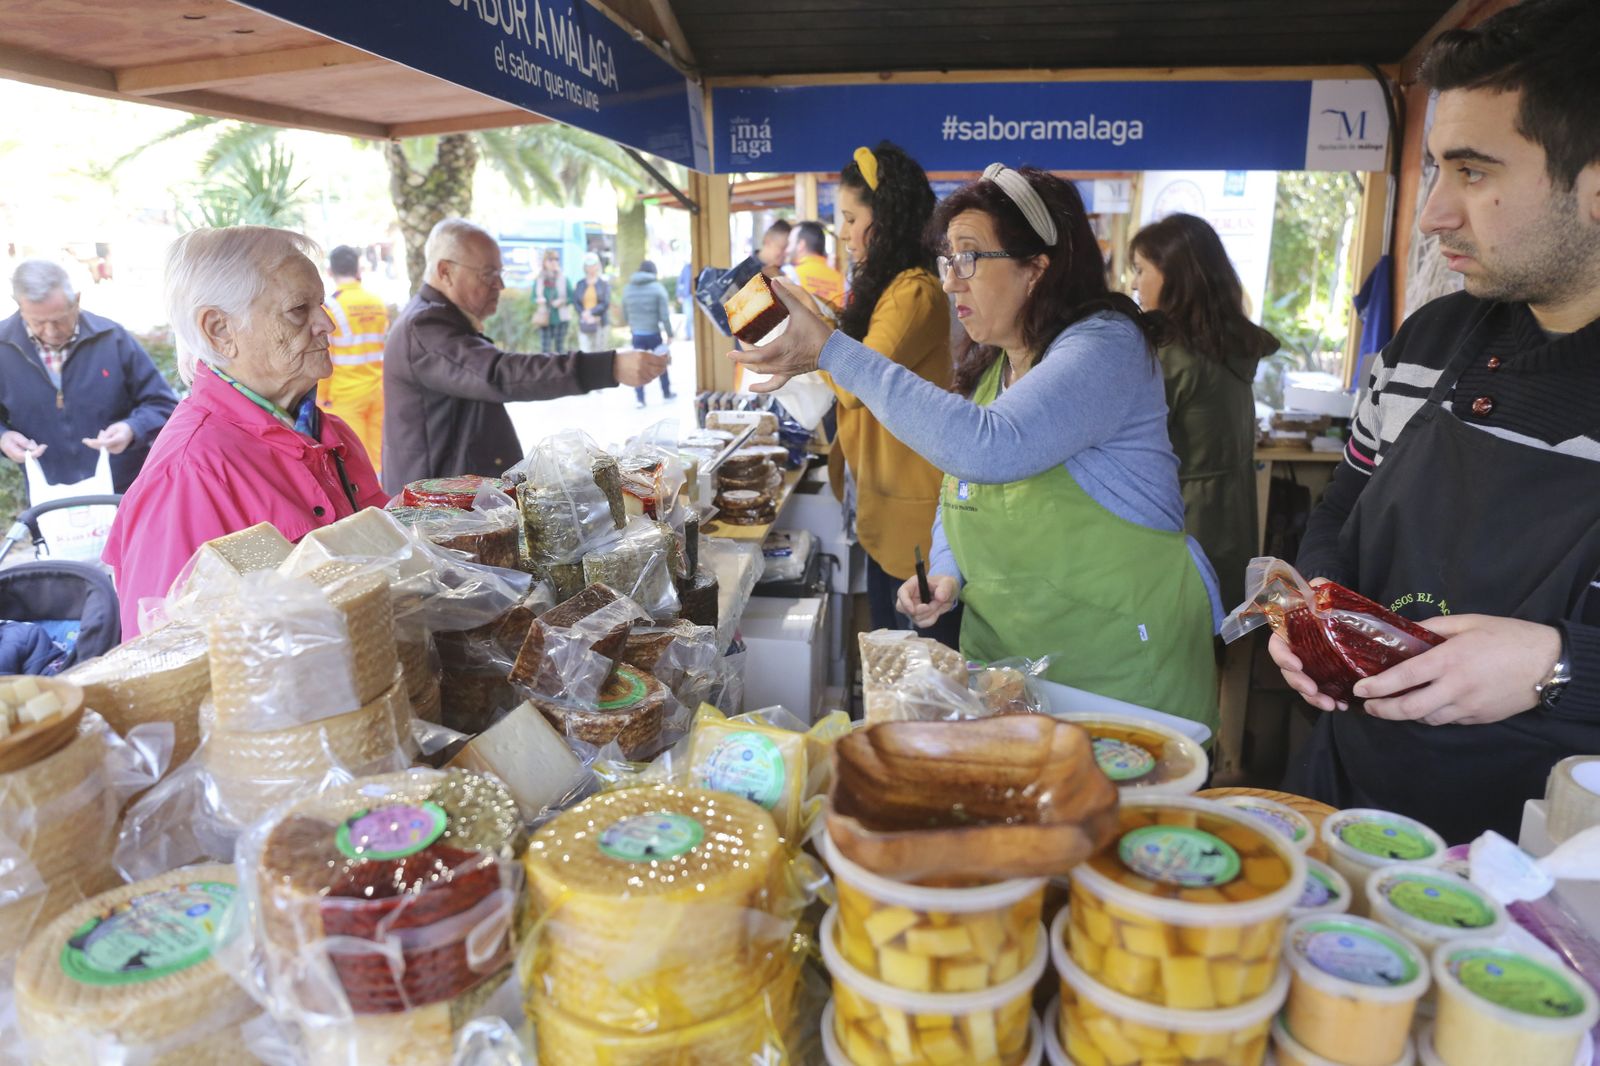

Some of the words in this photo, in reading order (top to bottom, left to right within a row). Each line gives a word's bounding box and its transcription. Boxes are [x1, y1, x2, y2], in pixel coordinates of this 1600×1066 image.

[535, 0, 550, 55] A
[549, 7, 619, 92] MÁLAGA
[494, 40, 508, 74] el
[509, 50, 542, 88] sabor
[543, 69, 564, 100] que
[564, 79, 582, 105] nos
[582, 87, 600, 113] une
[737, 117, 772, 139] má
[942, 113, 1144, 146] #saboramalaga
[731, 134, 772, 159] laga
[1416, 592, 1434, 604] EL
